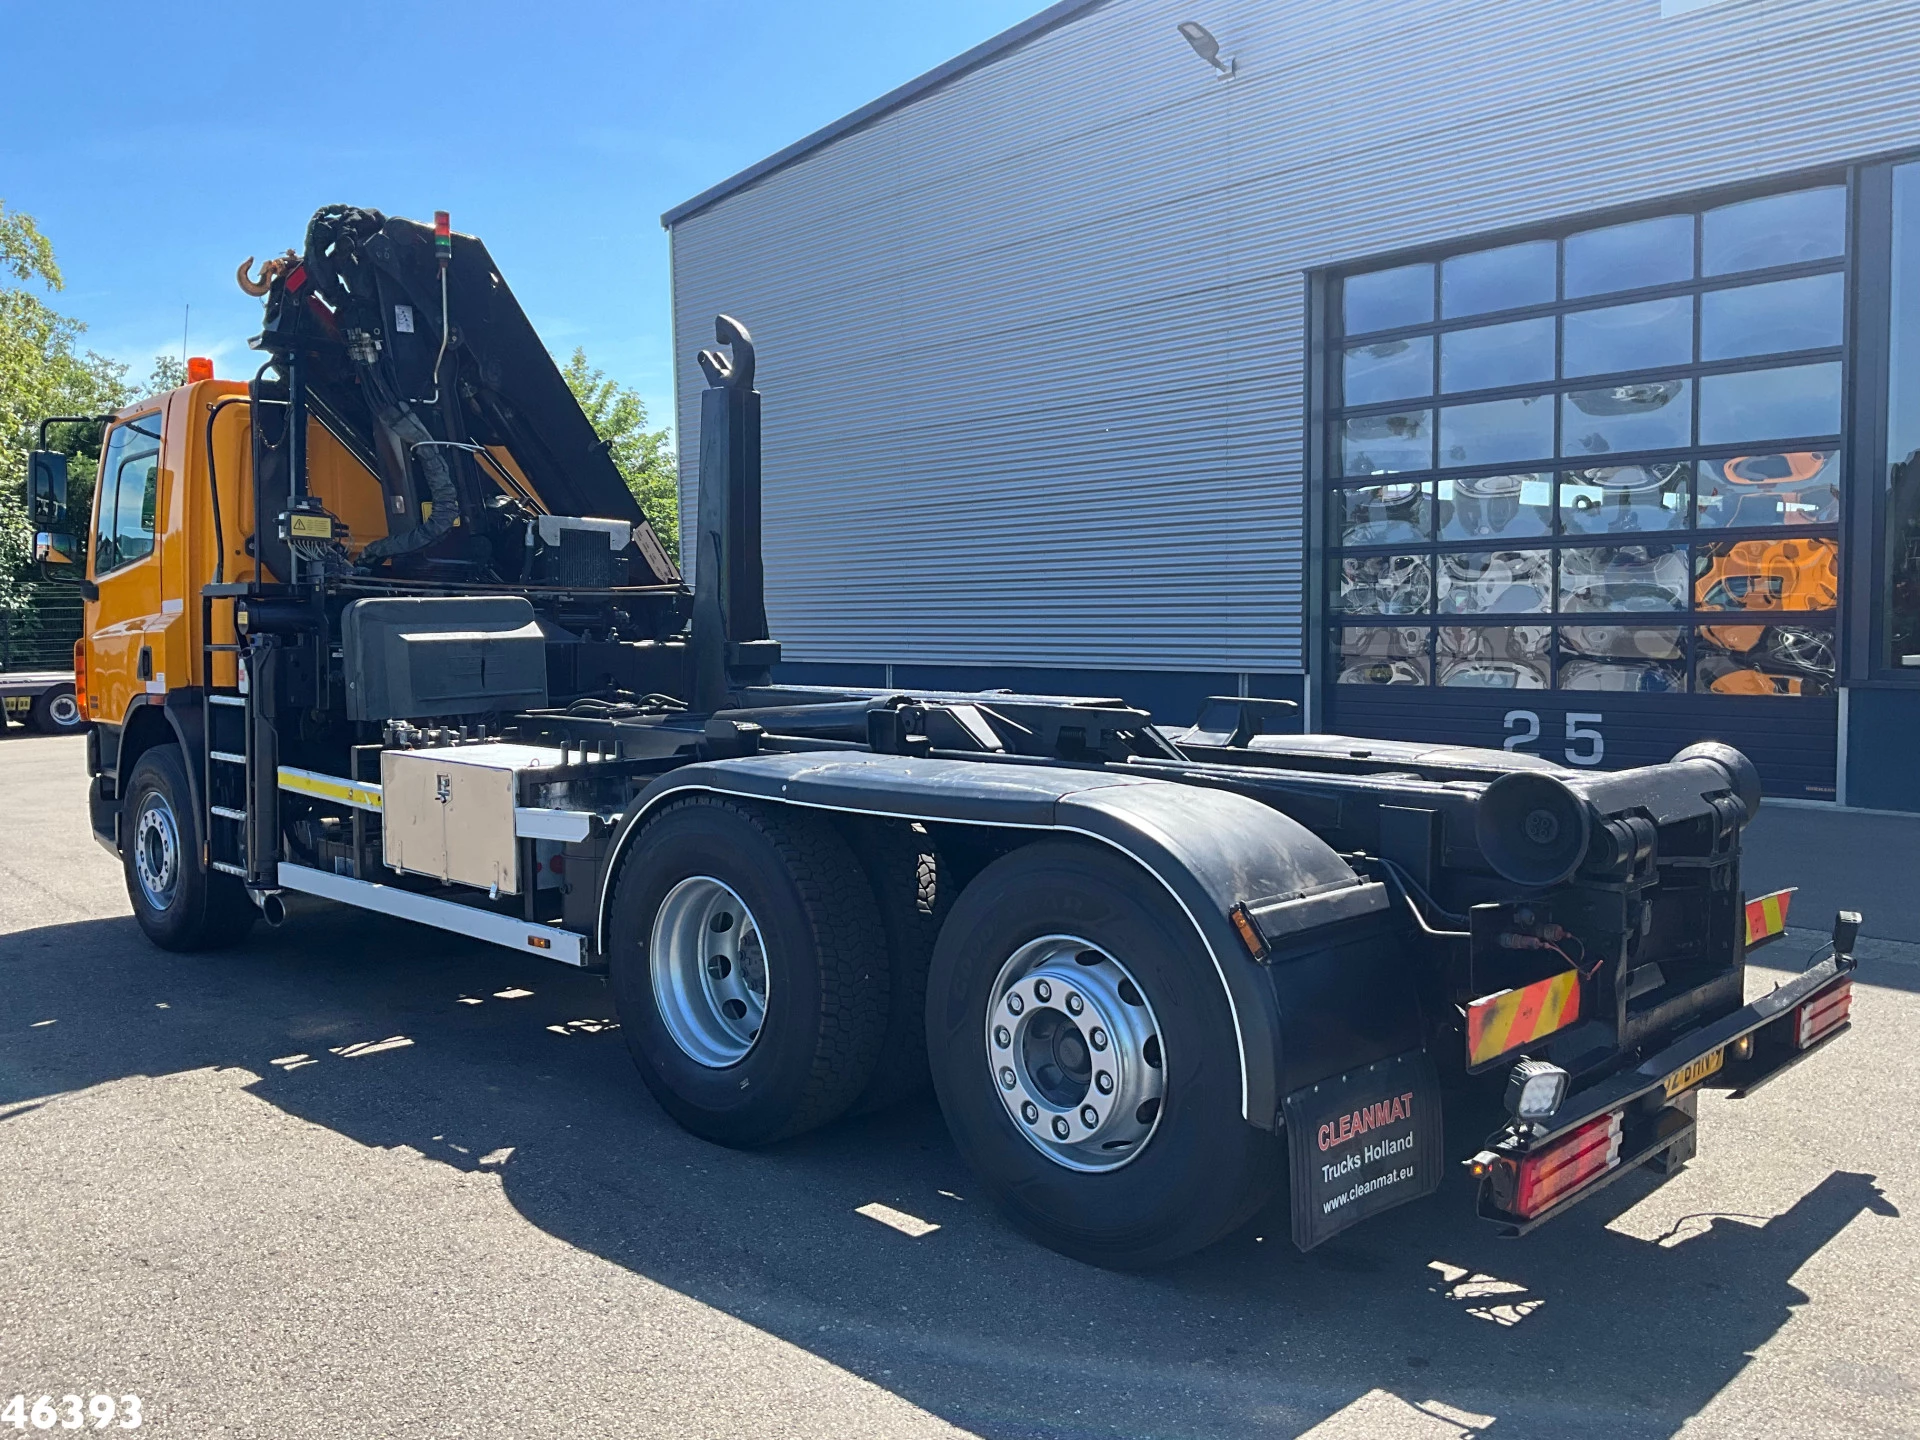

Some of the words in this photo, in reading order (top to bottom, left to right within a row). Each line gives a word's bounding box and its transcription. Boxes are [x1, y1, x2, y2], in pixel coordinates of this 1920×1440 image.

[1317, 1092, 1413, 1151] CLEANMAT
[1321, 1154, 1361, 1183] Trucks
[1364, 1131, 1413, 1163] Holland
[1322, 1165, 1413, 1214] www.cleanmat.eu
